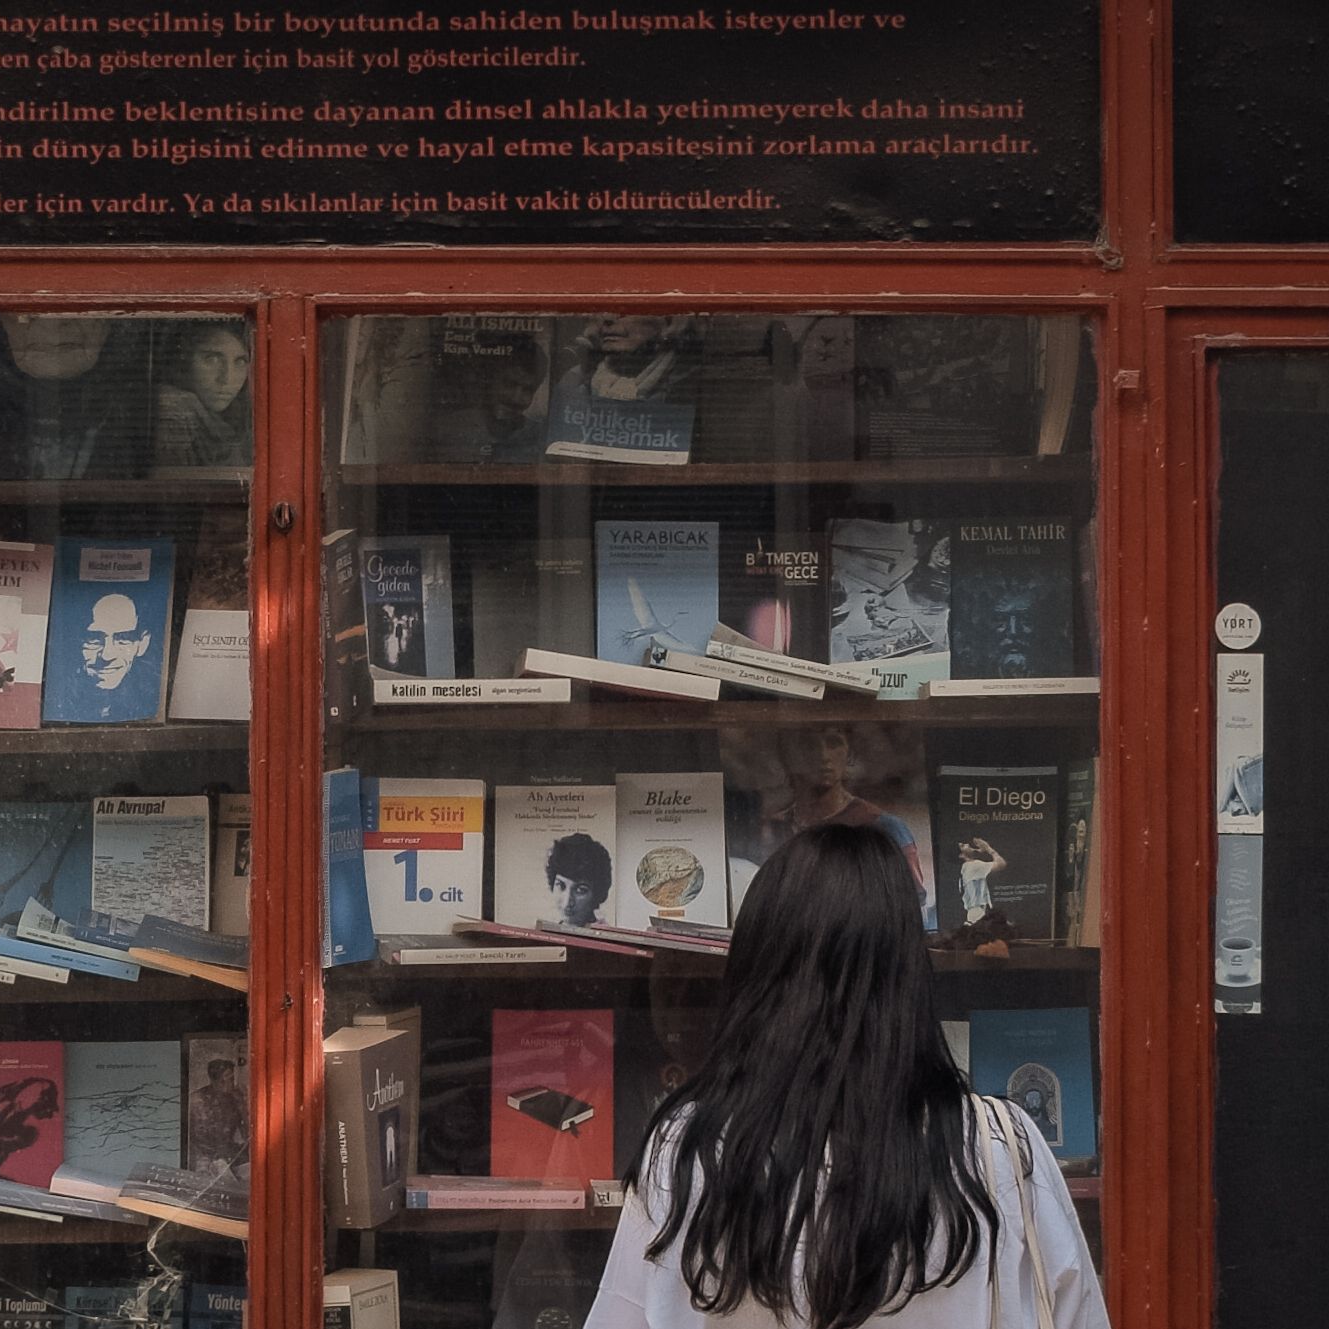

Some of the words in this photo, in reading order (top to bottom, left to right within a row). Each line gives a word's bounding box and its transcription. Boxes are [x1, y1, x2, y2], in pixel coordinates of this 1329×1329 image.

[107, 11, 225, 37] seçilmiş
[234, 11, 272, 32] bir
[284, 11, 441, 34] boyutunda
[449, 10, 562, 31] sahiden
[571, 9, 714, 33] buluşmak
[725, 9, 863, 32] isteyenler
[874, 15, 905, 28] ve
[35, 48, 92, 72] çaba
[99, 48, 236, 75] gösterenler
[243, 50, 289, 72] için
[296, 48, 354, 69] basit
[362, 48, 400, 72] yol
[407, 47, 586, 73] göstericilerdir.
[124, 100, 304, 122] beklentisine
[312, 100, 436, 127] dayanan
[444, 98, 533, 120] dinsel
[542, 98, 649, 120] ahlakla
[658, 98, 853, 123] yetinmeyerek
[860, 97, 929, 119] daha
[938, 101, 1024, 119] insani
[32, 137, 122, 164] dünya
[131, 137, 252, 165] bilgisini
[260, 137, 368, 159] edinme
[376, 143, 409, 158] ve
[418, 136, 496, 163] hayal
[503, 139, 573, 157] etme
[582, 135, 755, 162] kapasitesini
[763, 135, 877, 156] zorlama
[884, 132, 1039, 159] araçlarıdır.
[35, 194, 84, 217] için
[90, 192, 175, 213] vardır.
[183, 193, 215, 214] Ya
[222, 192, 254, 213] da
[259, 192, 384, 213] sıkılanlar
[391, 192, 439, 217] için
[446, 191, 508, 212] basit
[515, 191, 581, 212] vakit
[586, 187, 781, 210] öldürücülerdir.
[564, 405, 652, 433] tehlikeli
[581, 425, 679, 449] yaşamak
[960, 526, 1013, 542] KEMAL
[1018, 522, 1066, 540] TAHİR
[785, 566, 819, 580] GECE
[377, 578, 412, 598] giden
[391, 682, 427, 698] katilin
[431, 682, 483, 698] meselesi
[527, 791, 544, 802] Ah
[645, 791, 692, 807] Blake
[959, 787, 978, 806] El
[986, 787, 1046, 810] Diego
[96, 800, 115, 815] Ah
[116, 801, 166, 817] Avrupa!
[383, 805, 425, 822] Türk
[430, 805, 465, 826] Şiiri
[958, 810, 990, 822] Diego
[393, 850, 434, 903] 1.
[439, 886, 464, 903] cilt
[4, 1297, 47, 1314] Toplumu
